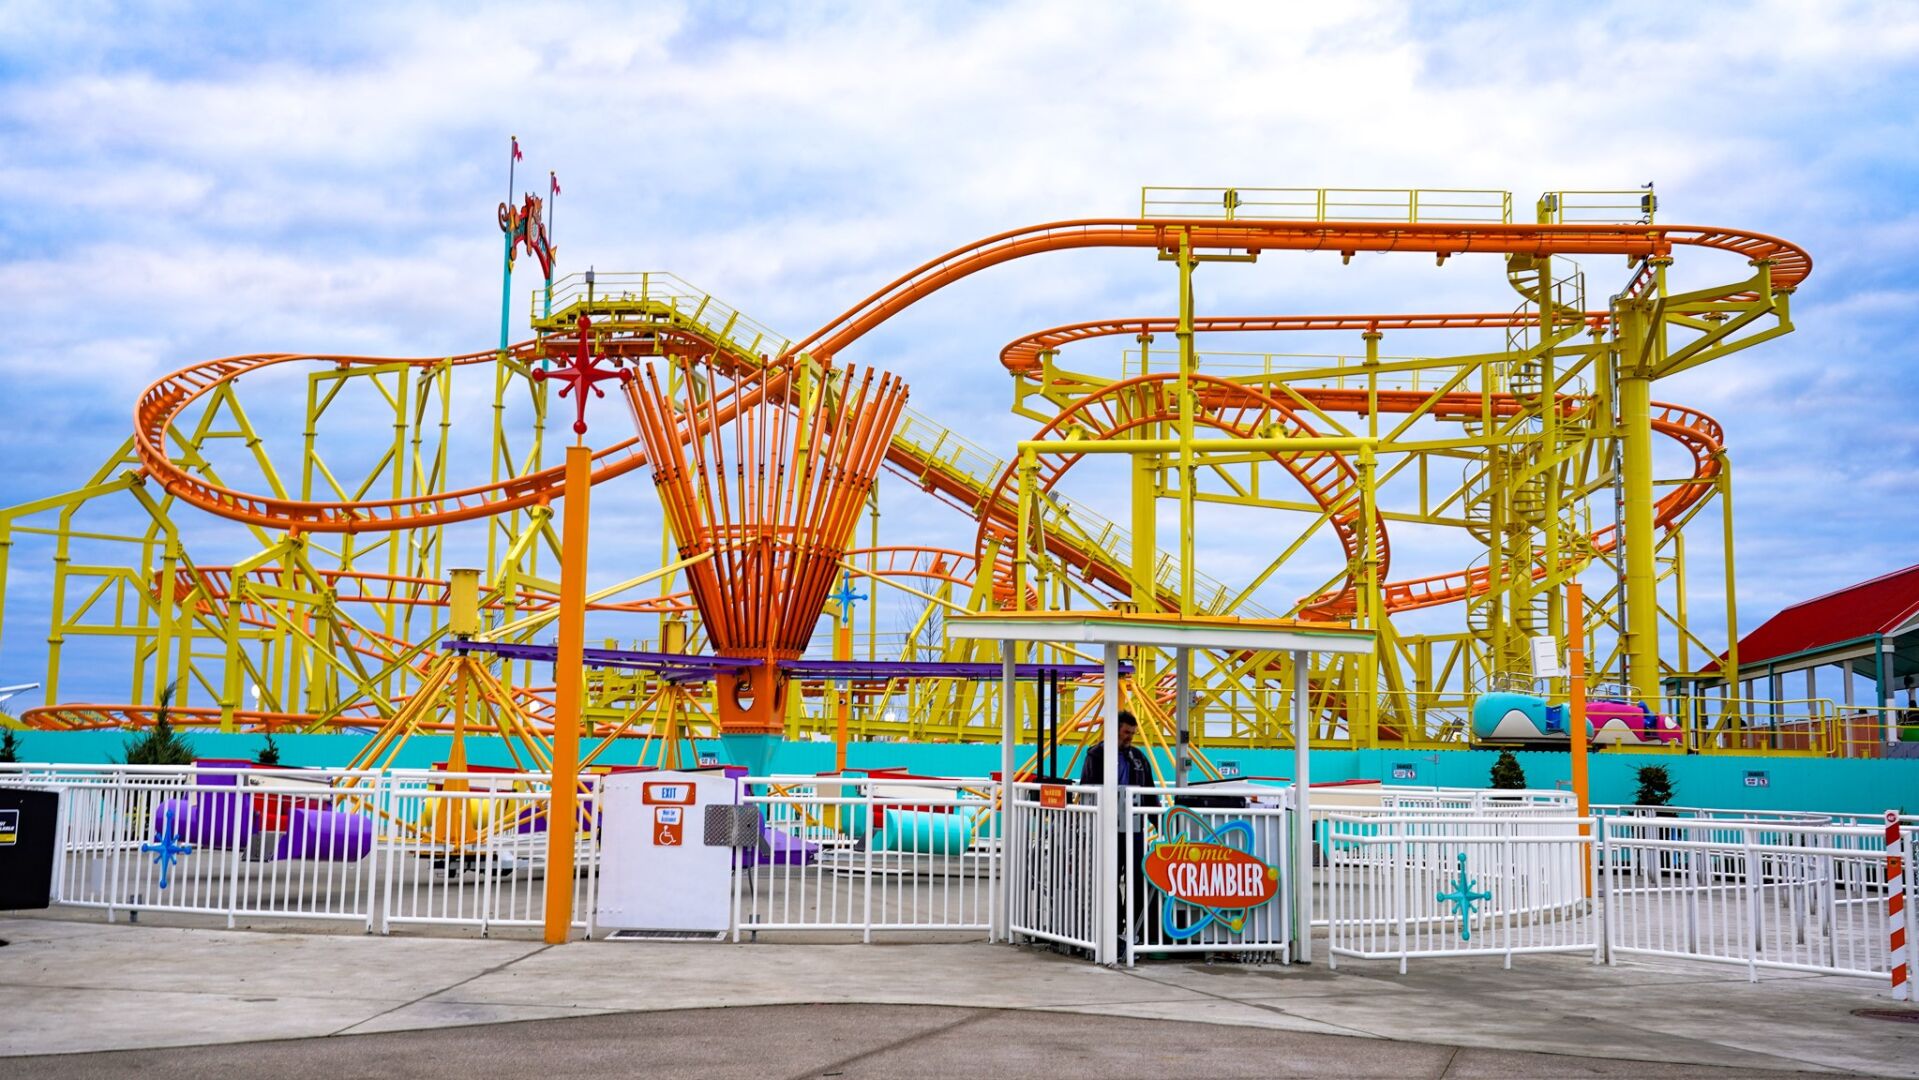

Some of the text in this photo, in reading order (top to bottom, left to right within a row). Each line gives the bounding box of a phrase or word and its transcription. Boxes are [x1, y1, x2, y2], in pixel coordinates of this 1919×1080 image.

[661, 787, 676, 798] EXIT
[1155, 834, 1232, 862] Atomic
[1167, 862, 1265, 897] SCRAMBLER
